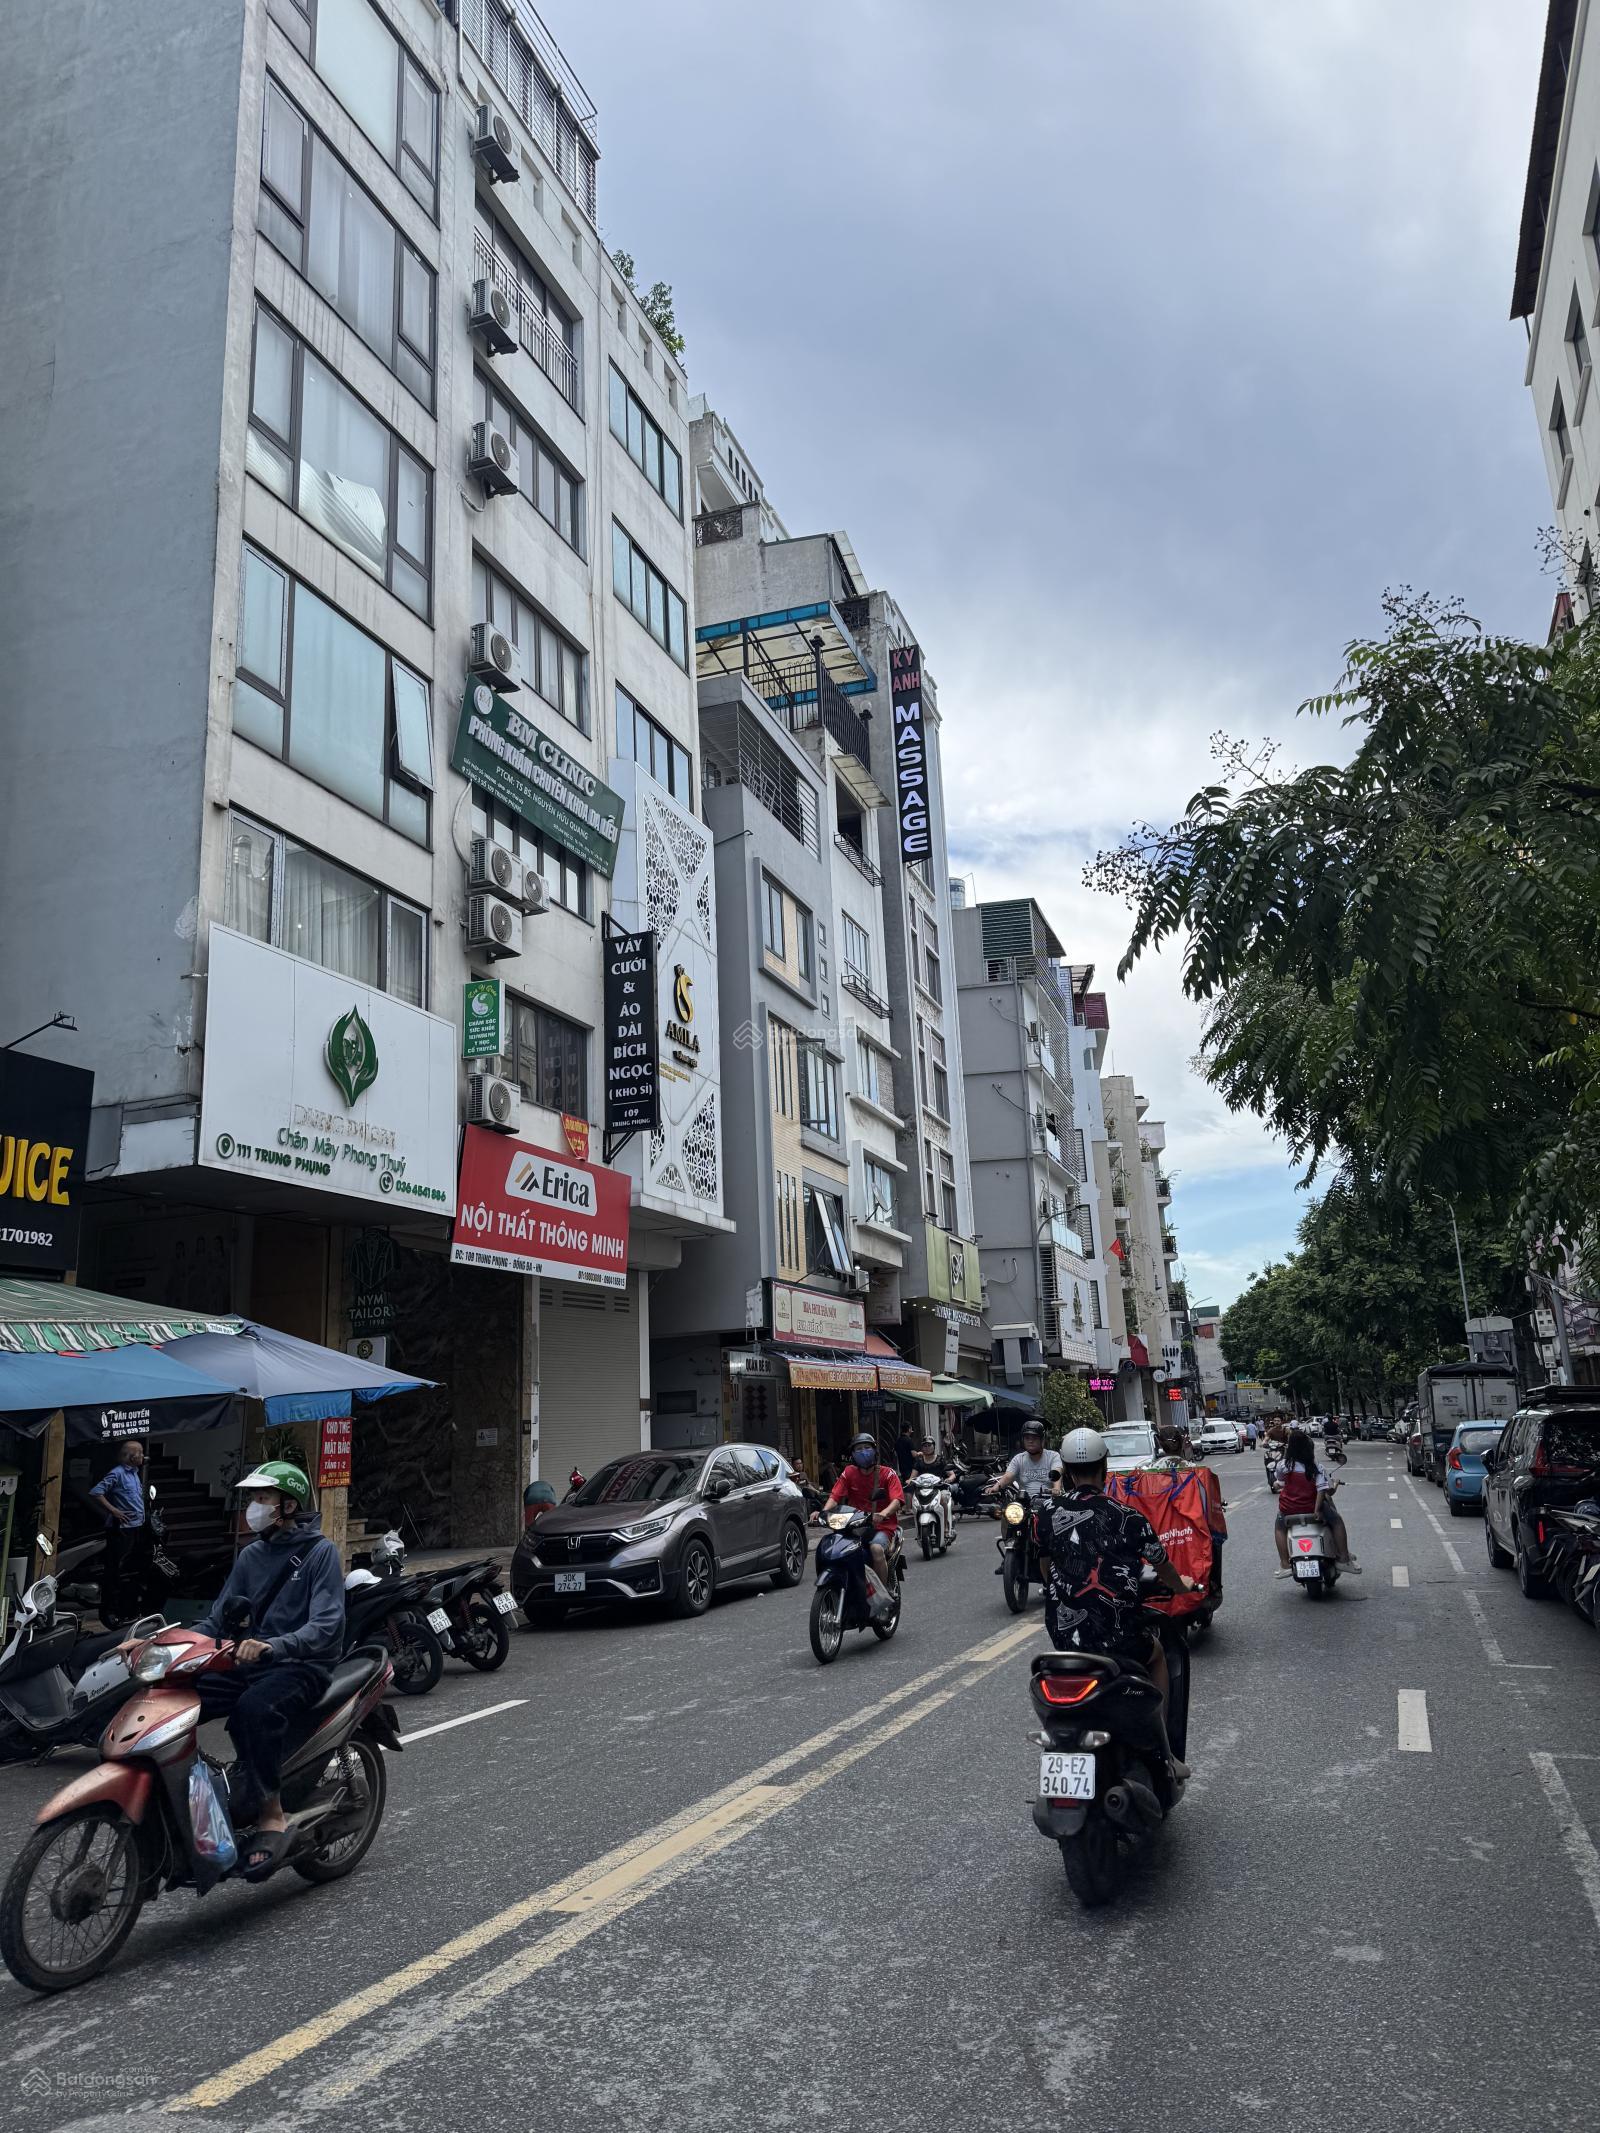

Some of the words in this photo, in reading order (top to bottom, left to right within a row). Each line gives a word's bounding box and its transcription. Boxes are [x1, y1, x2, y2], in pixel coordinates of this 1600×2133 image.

[892, 671, 921, 693] ANH
[506, 711, 539, 752] BM
[539, 740, 597, 798] CLINIC
[468, 714, 506, 757] PHÒNG
[503, 742, 534, 780] KHÁM
[533, 764, 568, 805] CHUYÊN
[566, 789, 589, 824] KHOA
[895, 702, 929, 854] MASSAGE
[496, 766, 515, 787] PTCM:
[516, 779, 523, 793] TS
[569, 816, 589, 840] QUANG
[615, 938, 643, 955] VÁY
[611, 958, 647, 976] CƯỚI
[622, 981, 636, 994] &
[619, 1002, 641, 1018] ÁO
[617, 1023, 642, 1038] DÀI
[665, 1019, 701, 1054] AMILA
[613, 1041, 647, 1060] BÍCH
[609, 1062, 653, 1081] NGỌC
[615, 1086, 638, 1098] KHO
[624, 1108, 639, 1118] 109
[236, 1143, 252, 1159] 111
[255, 1148, 292, 1167] TRUNG
[295, 1156, 331, 1177] PHỤNG
[342, 1143, 378, 1172] Phong
[542, 1166, 590, 1208] Erica
[0, 1227, 53, 1247] 1701982
[460, 1201, 493, 1238] NỘI
[498, 1208, 536, 1241] THẤT
[539, 1220, 588, 1252] THÔNG
[591, 1233, 625, 1260] MINH
[465, 1251, 475, 1263] 109
[475, 1253, 492, 1266] TRUNG
[357, 1294, 384, 1306] NYM
[348, 1306, 391, 1320] TAILOR
[326, 1421, 338, 1434] CHO
[287, 1477, 306, 1495] Grab
[1158, 1526, 1193, 1541] ngNhanh
[562, 1573, 577, 1583] 30K
[1047, 1756, 1087, 1775] 29-E2
[1042, 1776, 1091, 1795] 340.74
